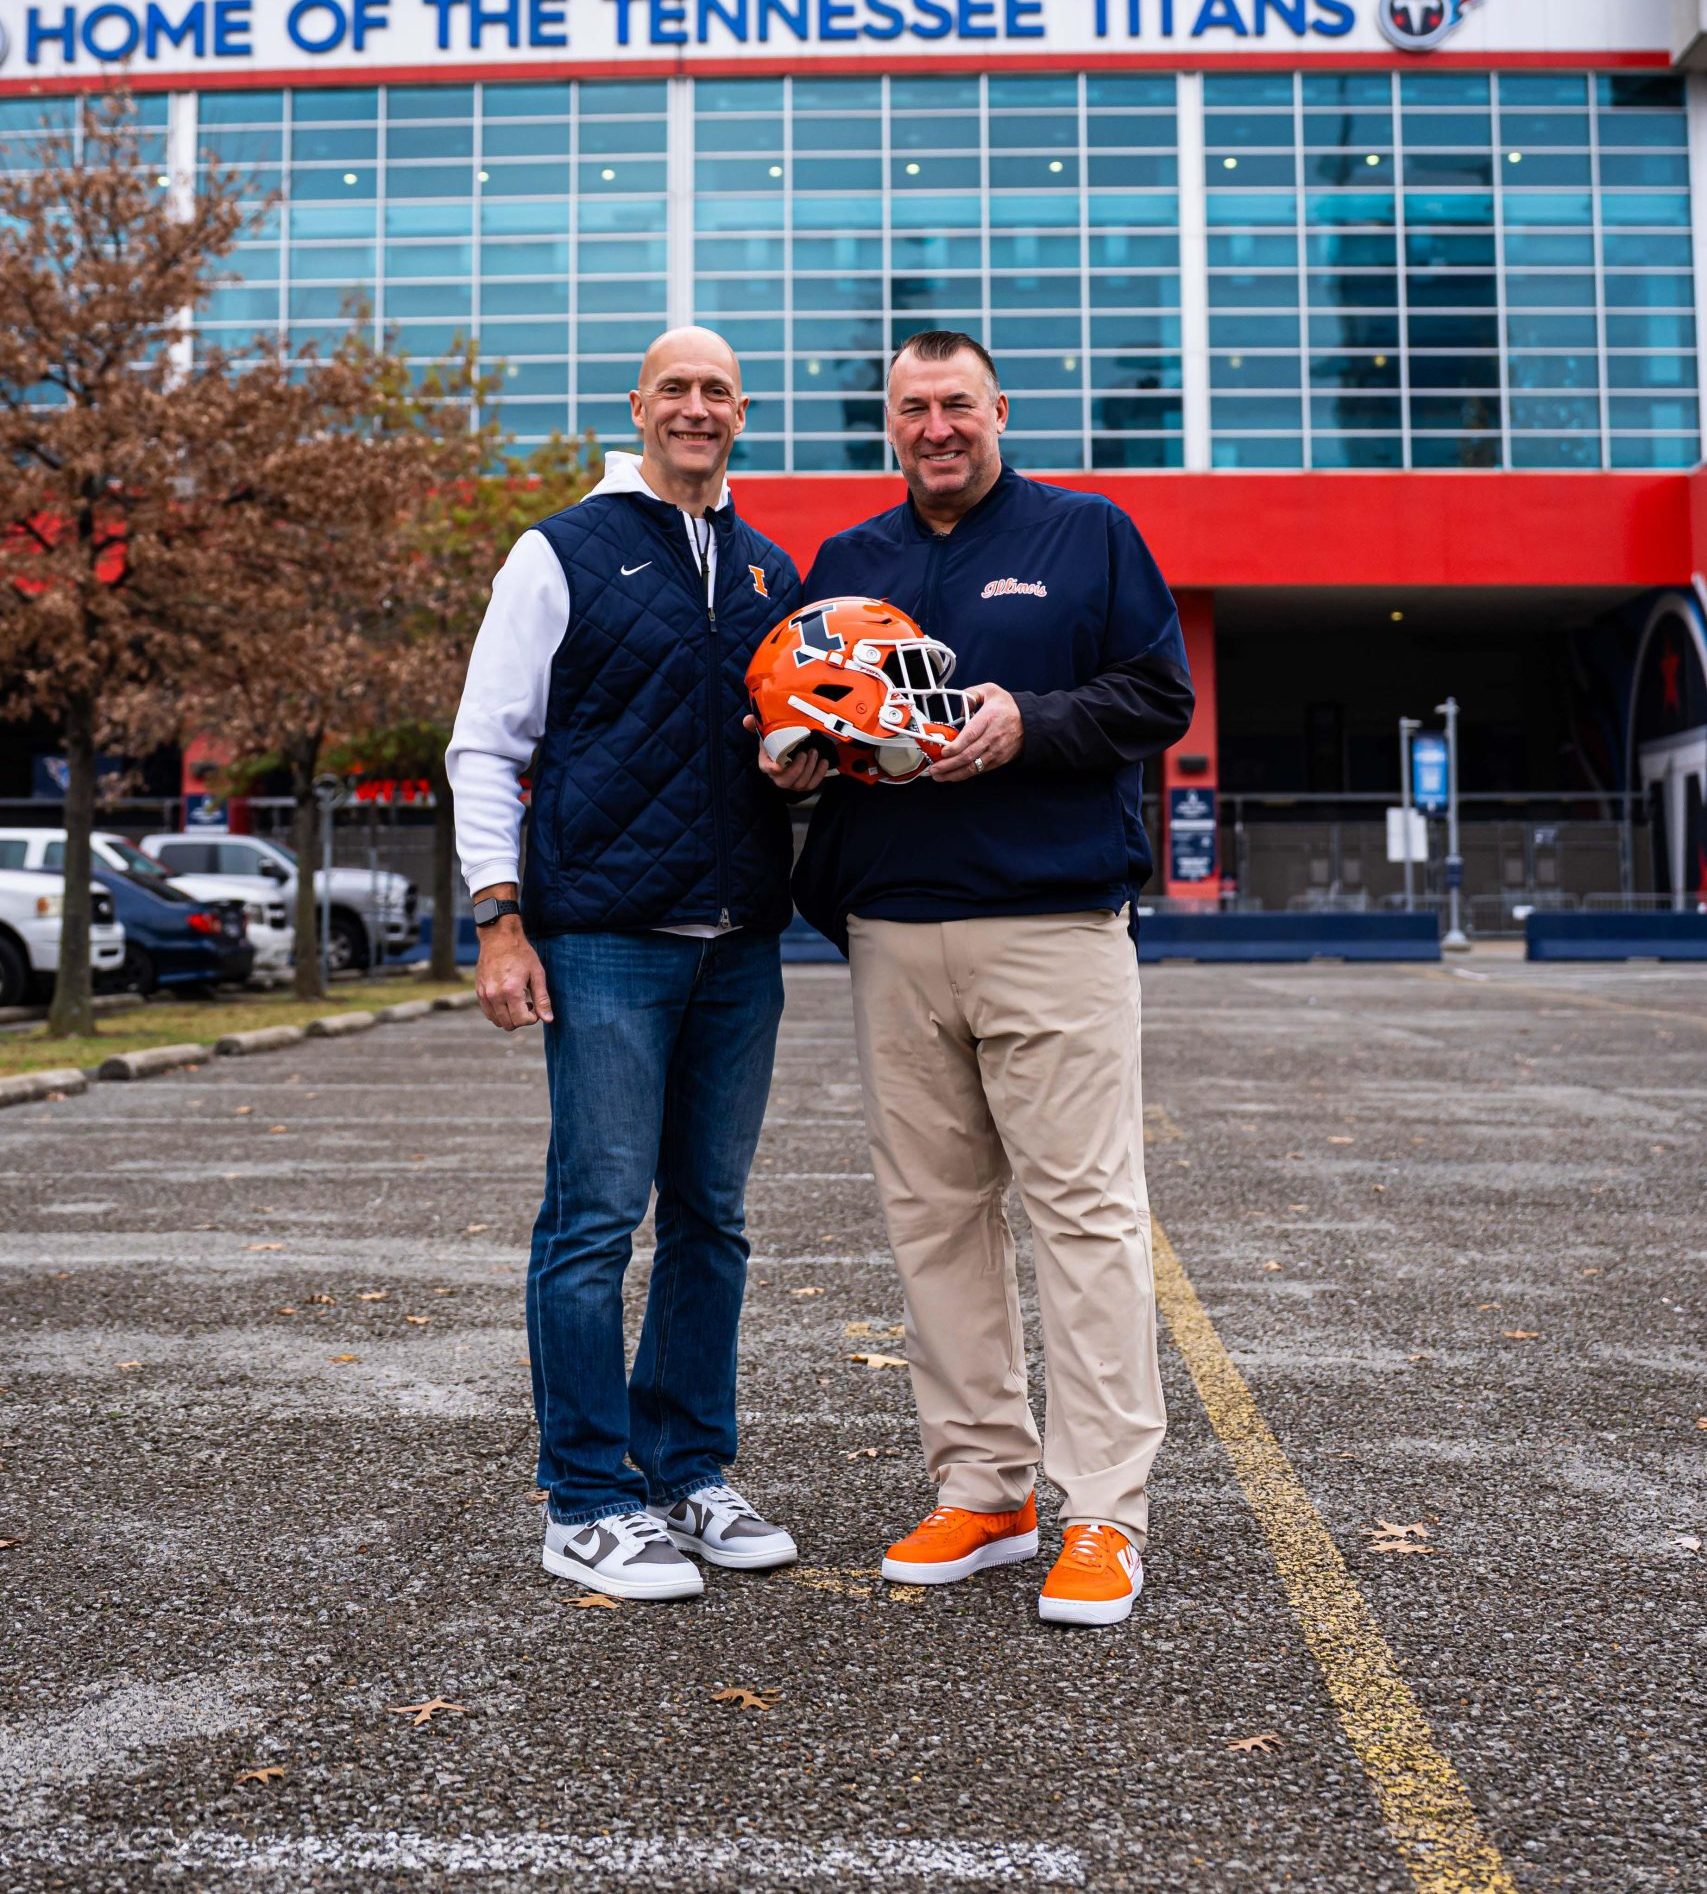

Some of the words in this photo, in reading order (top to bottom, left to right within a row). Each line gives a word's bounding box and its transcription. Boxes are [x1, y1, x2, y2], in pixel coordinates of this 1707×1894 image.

[27, 0, 254, 65] HOME
[287, 0, 390, 54] OF
[422, 0, 568, 49] THE
[613, 0, 1045, 46] TENNESSEE
[1094, 0, 1355, 37] TITANS
[981, 577, 1047, 599] Illinois
